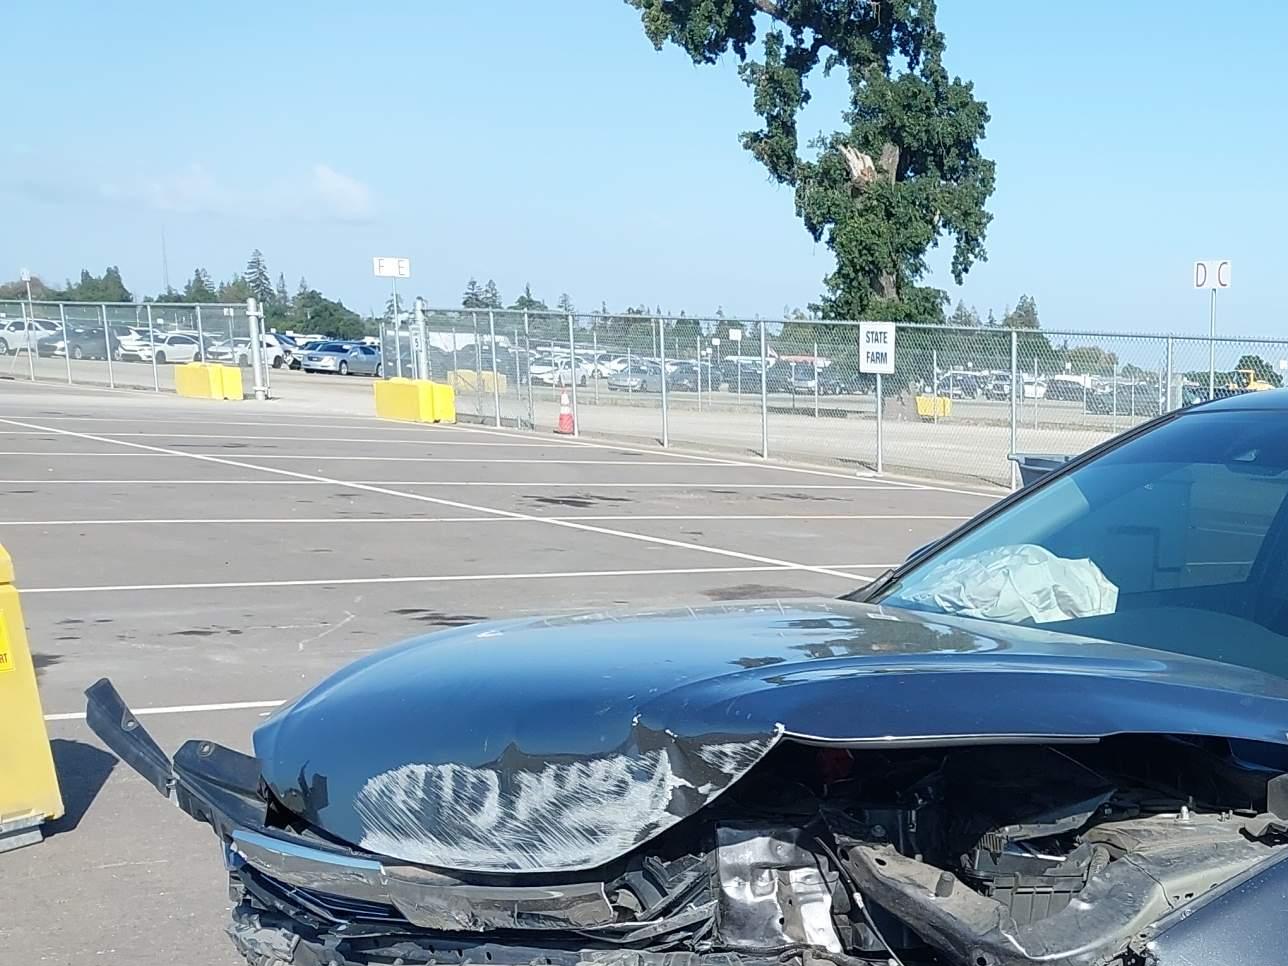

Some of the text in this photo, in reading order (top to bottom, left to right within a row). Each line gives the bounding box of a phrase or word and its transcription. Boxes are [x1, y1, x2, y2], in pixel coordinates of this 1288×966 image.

[398, 259, 407, 276] E
[1196, 261, 1228, 287] D C
[865, 330, 888, 344] STATE
[866, 351, 888, 365] FARM
